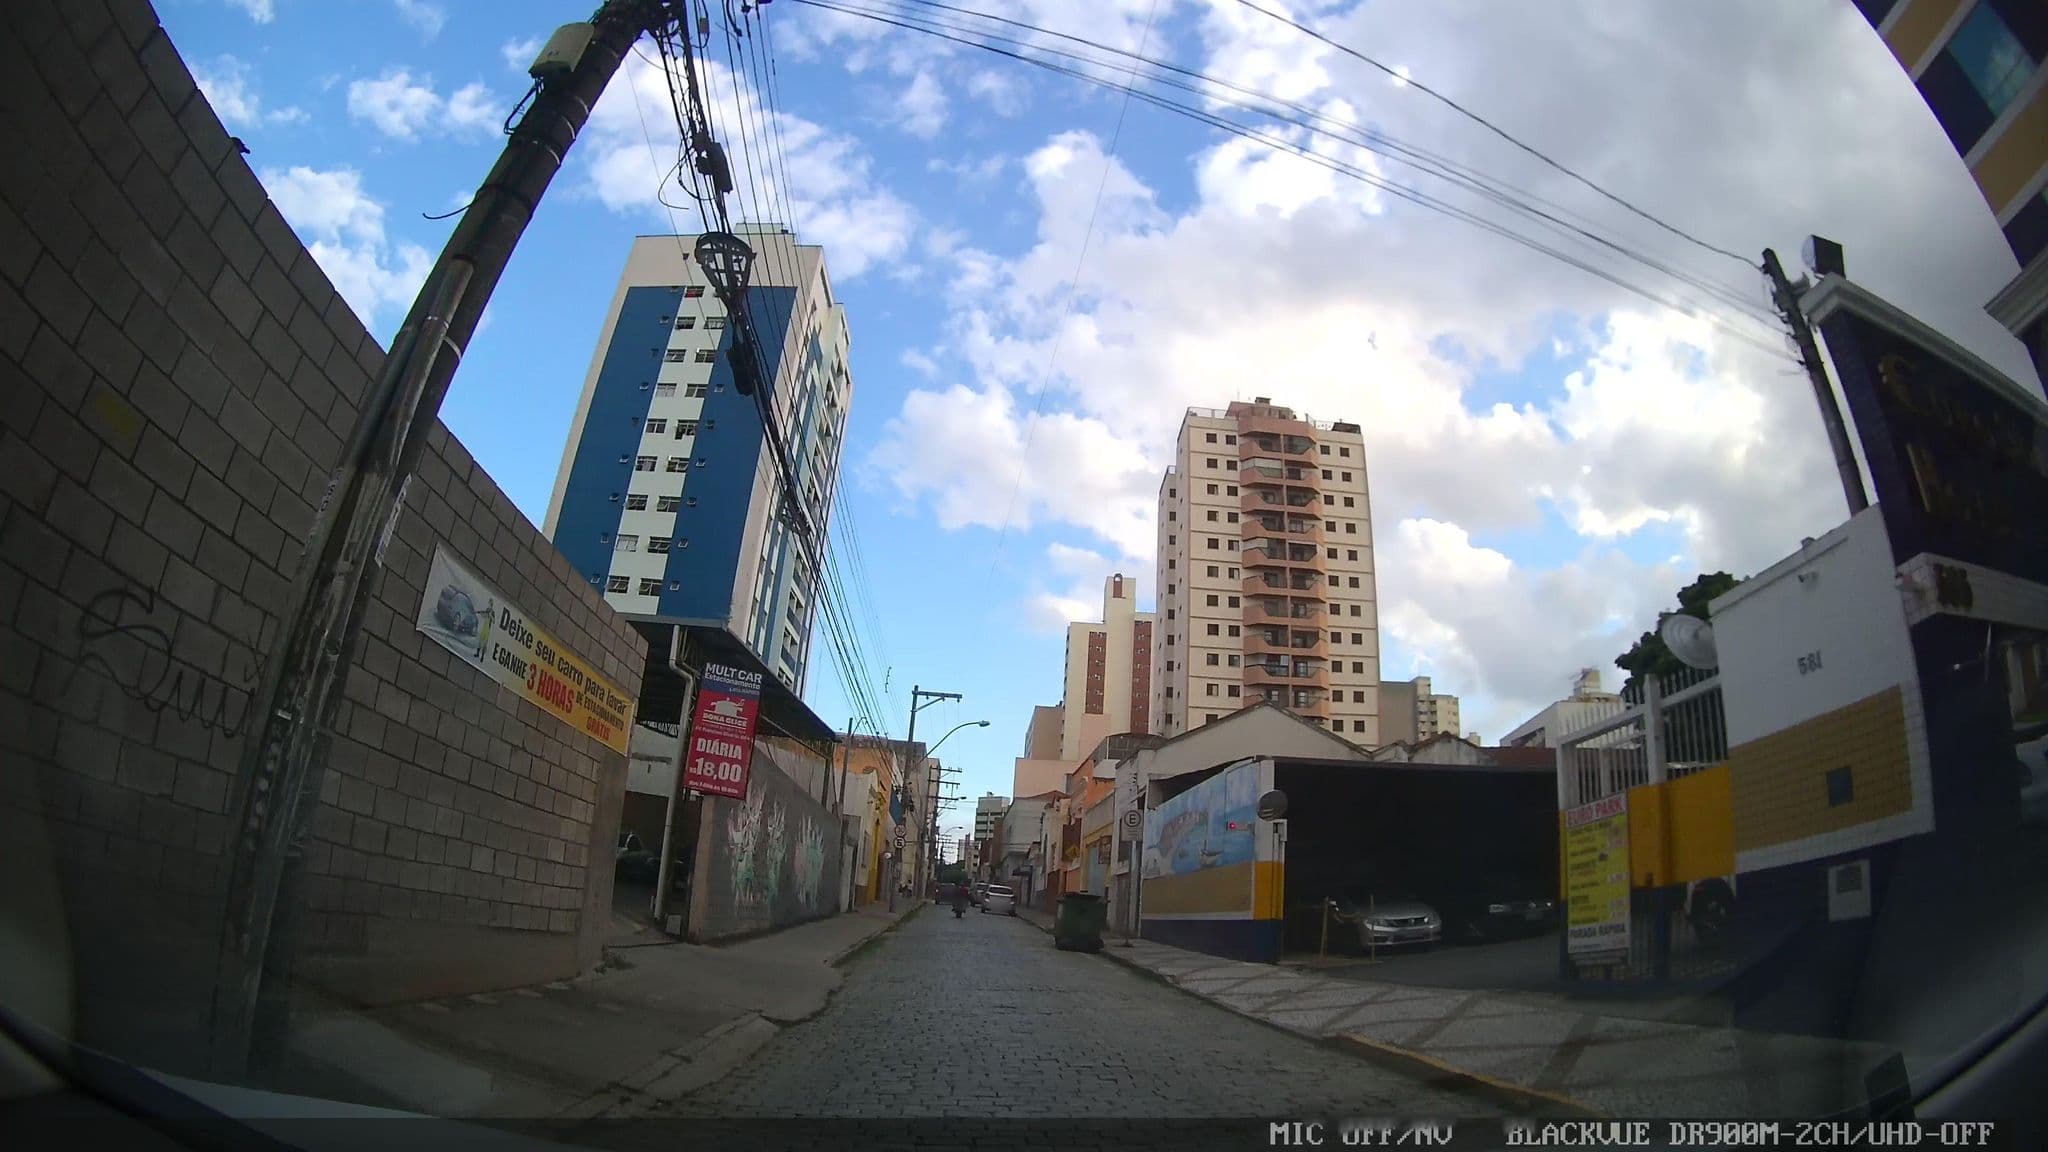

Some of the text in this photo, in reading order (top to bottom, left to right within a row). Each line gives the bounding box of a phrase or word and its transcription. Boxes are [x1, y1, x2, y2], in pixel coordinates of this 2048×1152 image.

[499, 607, 626, 716] Deixe seu carro para lavar
[527, 663, 537, 690] 3
[536, 670, 574, 714] HORAS
[704, 672, 761, 690] Estacionamento
[738, 670, 763, 684] CAR
[696, 737, 742, 760] DIÁRIA
